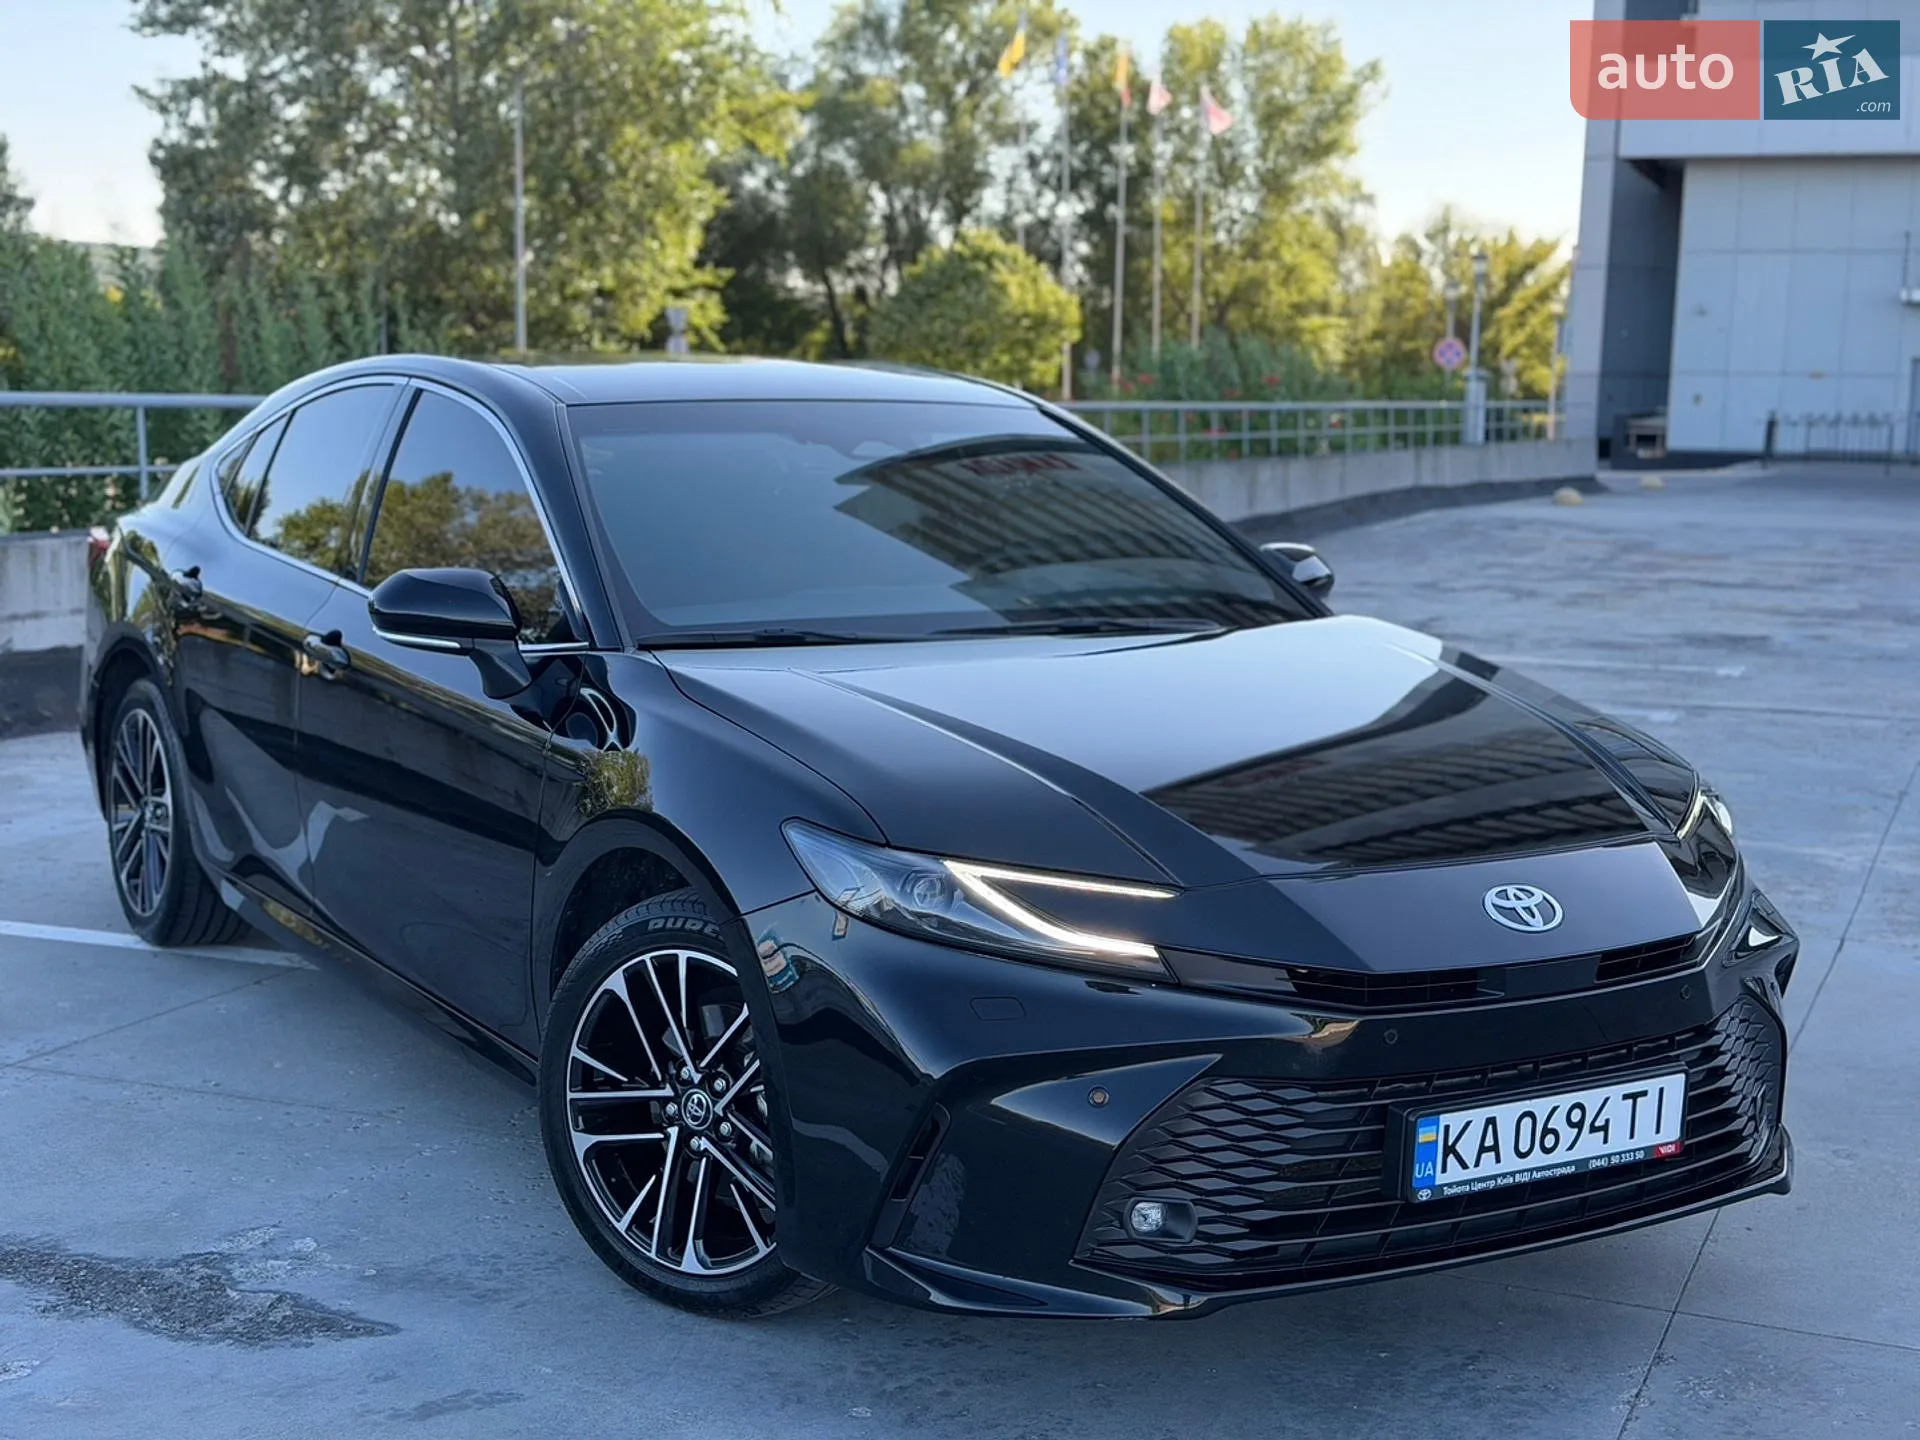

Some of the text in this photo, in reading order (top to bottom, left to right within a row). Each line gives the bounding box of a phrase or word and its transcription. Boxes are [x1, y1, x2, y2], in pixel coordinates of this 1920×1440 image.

[1415, 1161, 1434, 1178] UA
[1588, 1156, 1609, 1170] (044)
[1610, 1154, 1621, 1164] 50
[1621, 1152, 1635, 1163] 333
[1443, 1184, 1470, 1196] Тойота
[1471, 1179, 1496, 1192] Центр
[1532, 1164, 1576, 1180] Автострада
